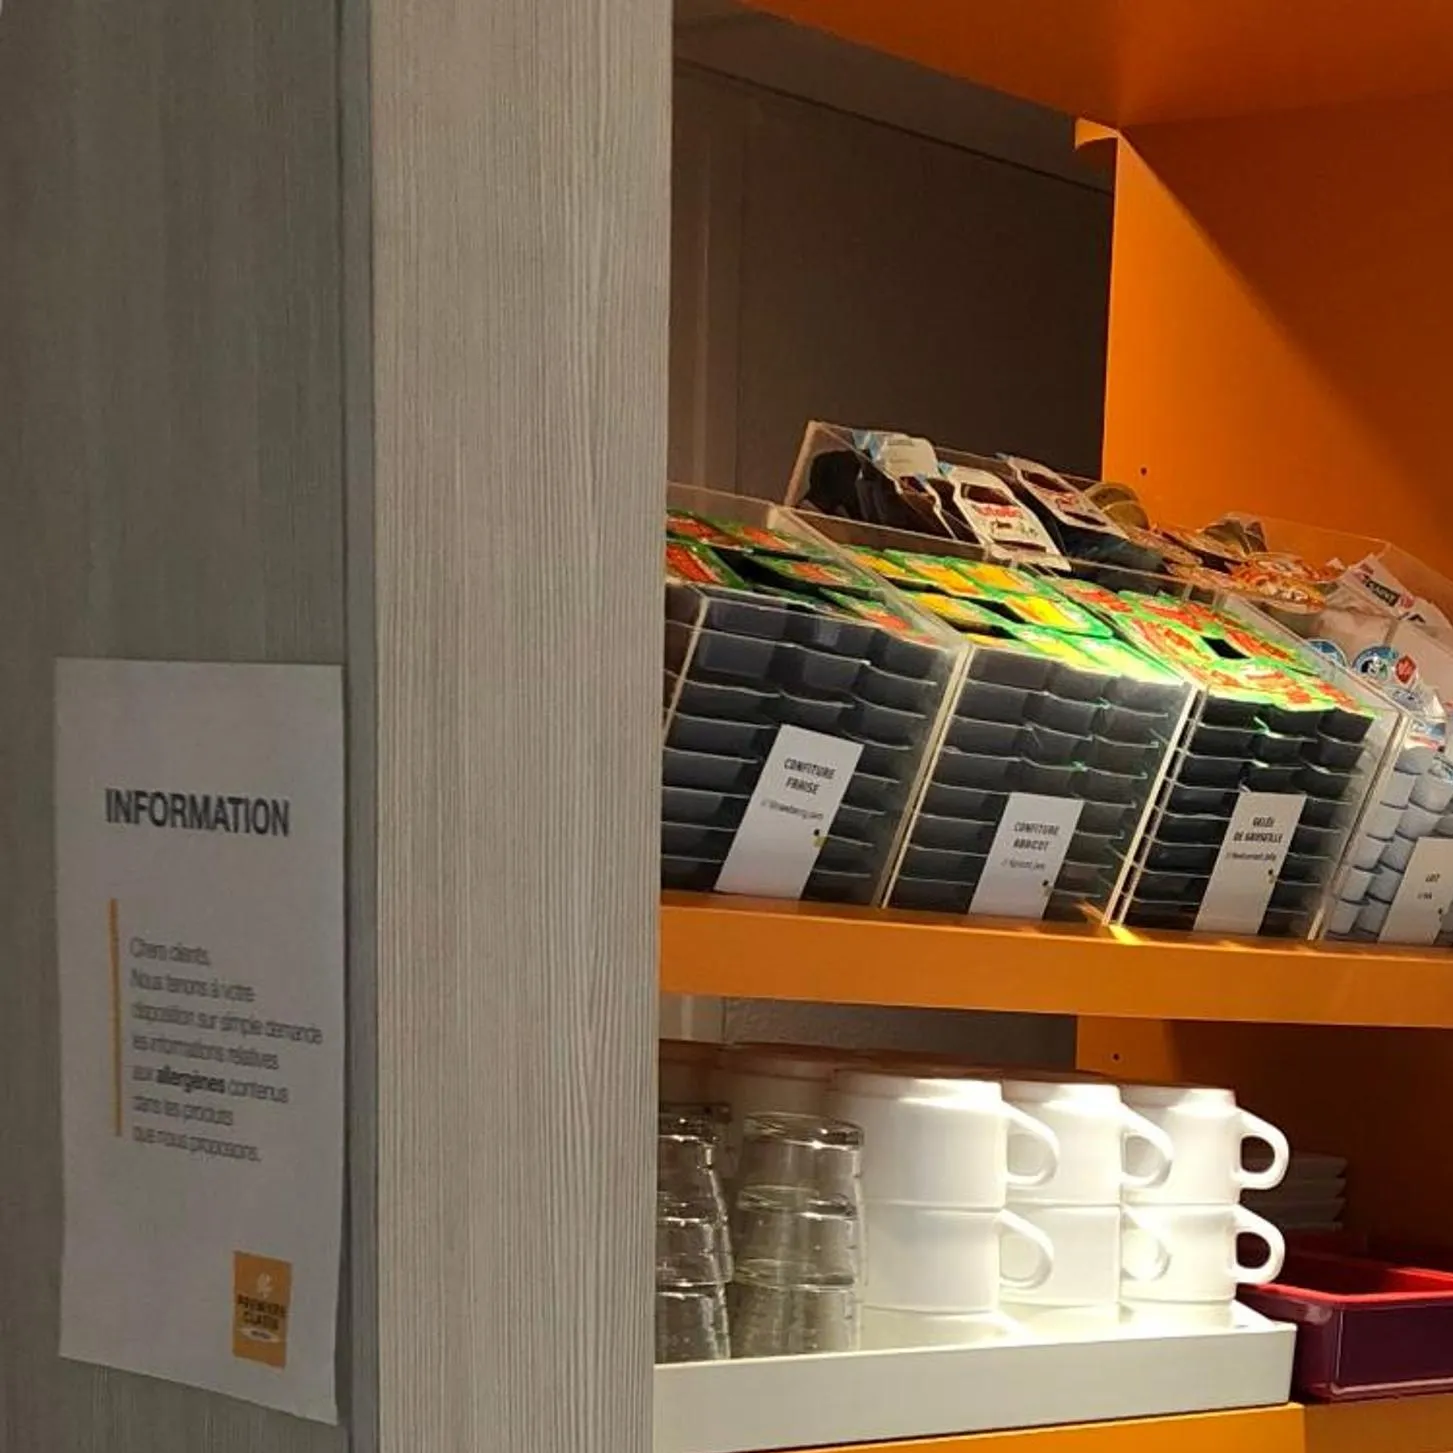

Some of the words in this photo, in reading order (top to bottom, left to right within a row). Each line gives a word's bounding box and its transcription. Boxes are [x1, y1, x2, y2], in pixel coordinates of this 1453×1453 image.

[784, 758, 836, 779] CONFITURE
[786, 776, 820, 795] FRAISE
[105, 788, 290, 836] INFORMATION
[1014, 821, 1060, 836] CONFITURE
[130, 969, 163, 991] Nous
[219, 1014, 263, 1038] simple
[156, 1065, 226, 1094] allergènes
[228, 1079, 290, 1104] contenus
